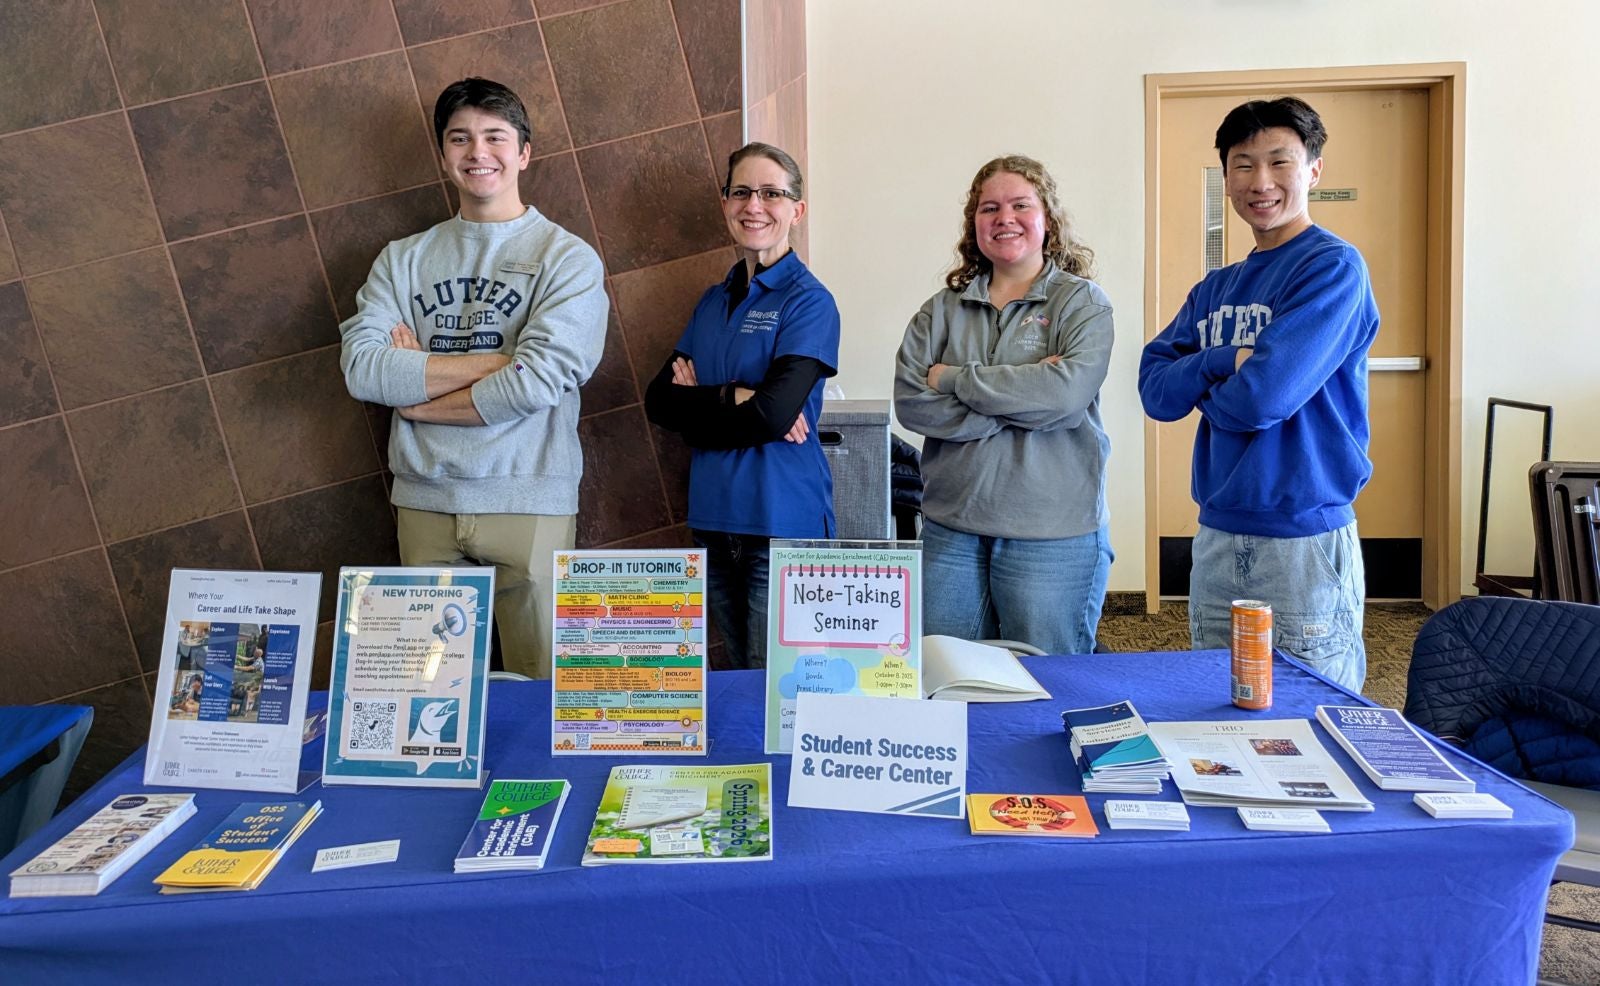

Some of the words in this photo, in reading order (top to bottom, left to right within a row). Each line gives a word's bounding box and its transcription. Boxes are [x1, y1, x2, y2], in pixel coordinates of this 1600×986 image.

[573, 562, 623, 574] DROP-IN
[626, 562, 681, 573] TUTORING
[188, 592, 208, 600] Where
[382, 589, 406, 597] NEW
[409, 589, 463, 598] TUTORING
[794, 583, 900, 608] Note-Taking
[197, 604, 222, 613] Career
[238, 606, 252, 614] Life
[255, 606, 272, 614] Take
[273, 607, 296, 617] Shape
[814, 612, 879, 632] Seminar
[804, 659, 827, 667] Where?
[812, 685, 834, 693] Library
[1338, 709, 1386, 719] LUTHER
[1341, 717, 1390, 726] COLLEGE
[801, 734, 872, 756] Student
[878, 738, 957, 761] Success
[802, 757, 815, 776] &
[821, 759, 884, 780] Career
[889, 763, 952, 785] Center
[502, 782, 552, 792] LUTHER
[494, 792, 550, 802] COLLEGE
[727, 784, 753, 816] Spring
[1007, 797, 1053, 809] S.O.S.
[221, 828, 279, 837] Student
[477, 831, 497, 856] Center
[490, 819, 503, 830] for
[490, 820, 515, 856] Academic
[503, 814, 530, 856] Enrichment
[521, 825, 540, 846] (CAE)
[731, 818, 753, 846] 2026
[194, 858, 240, 867] LUTHER
[183, 866, 232, 875] COLLEGE
